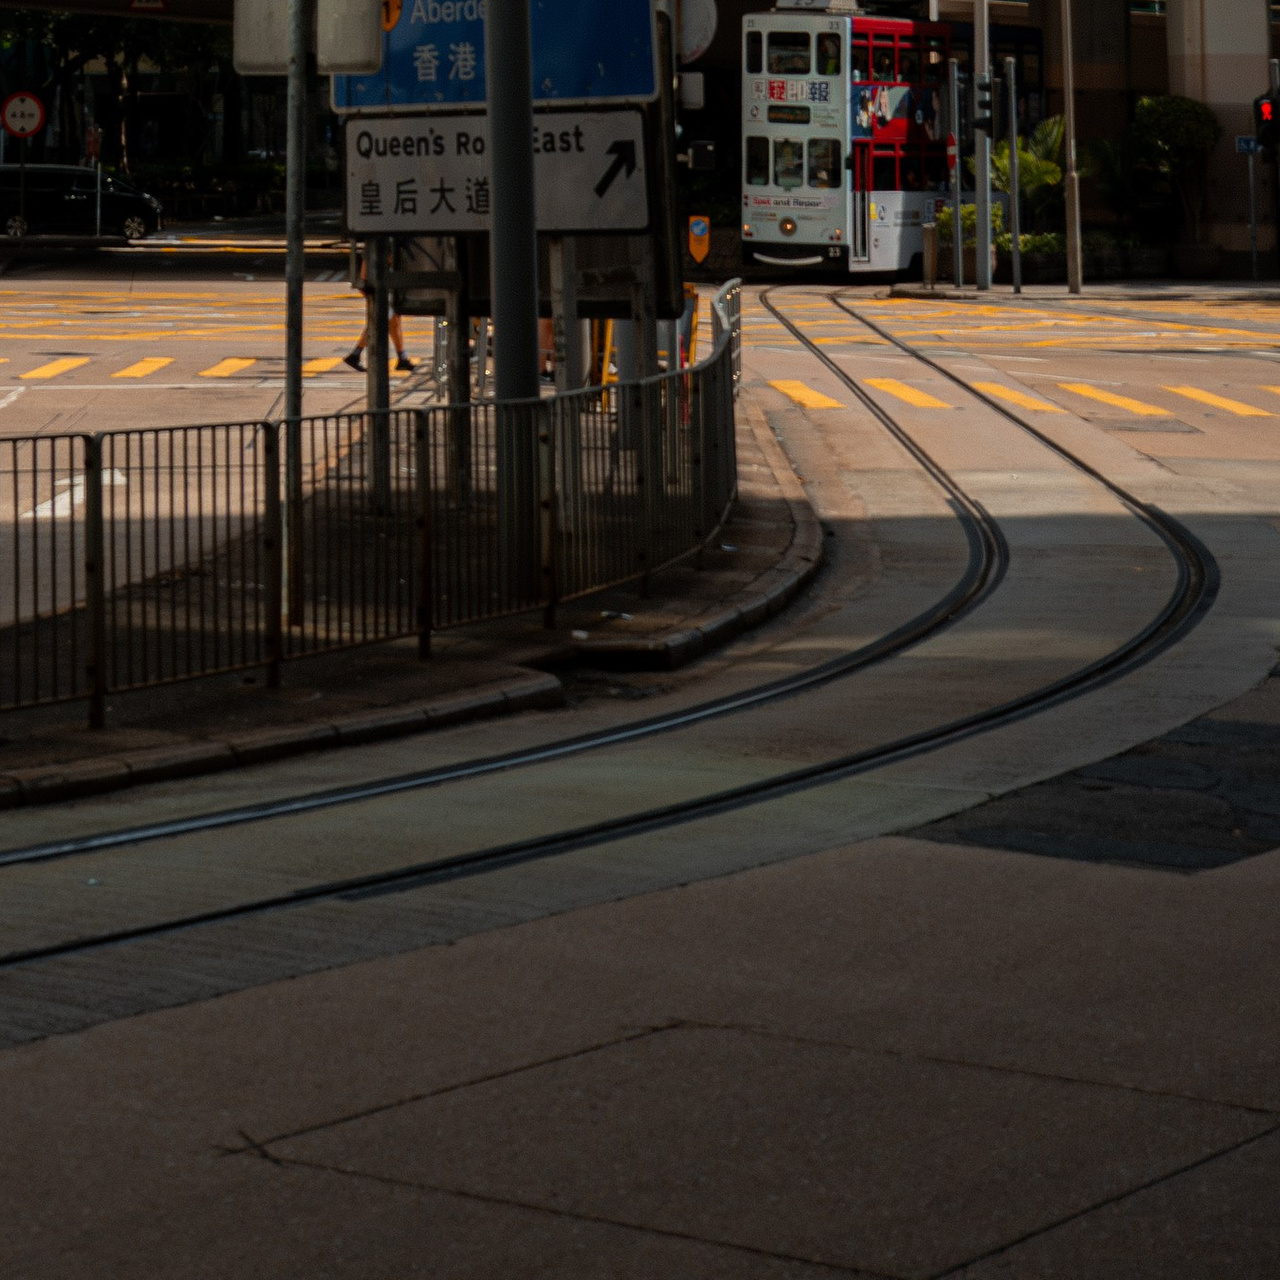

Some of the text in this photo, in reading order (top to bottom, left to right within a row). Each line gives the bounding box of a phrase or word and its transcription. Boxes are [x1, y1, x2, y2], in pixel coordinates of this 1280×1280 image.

[413, 42, 477, 82] 香港
[356, 127, 445, 159] Queen's
[456, 132, 485, 156] Ro
[360, 176, 490, 216] 皇后大道
